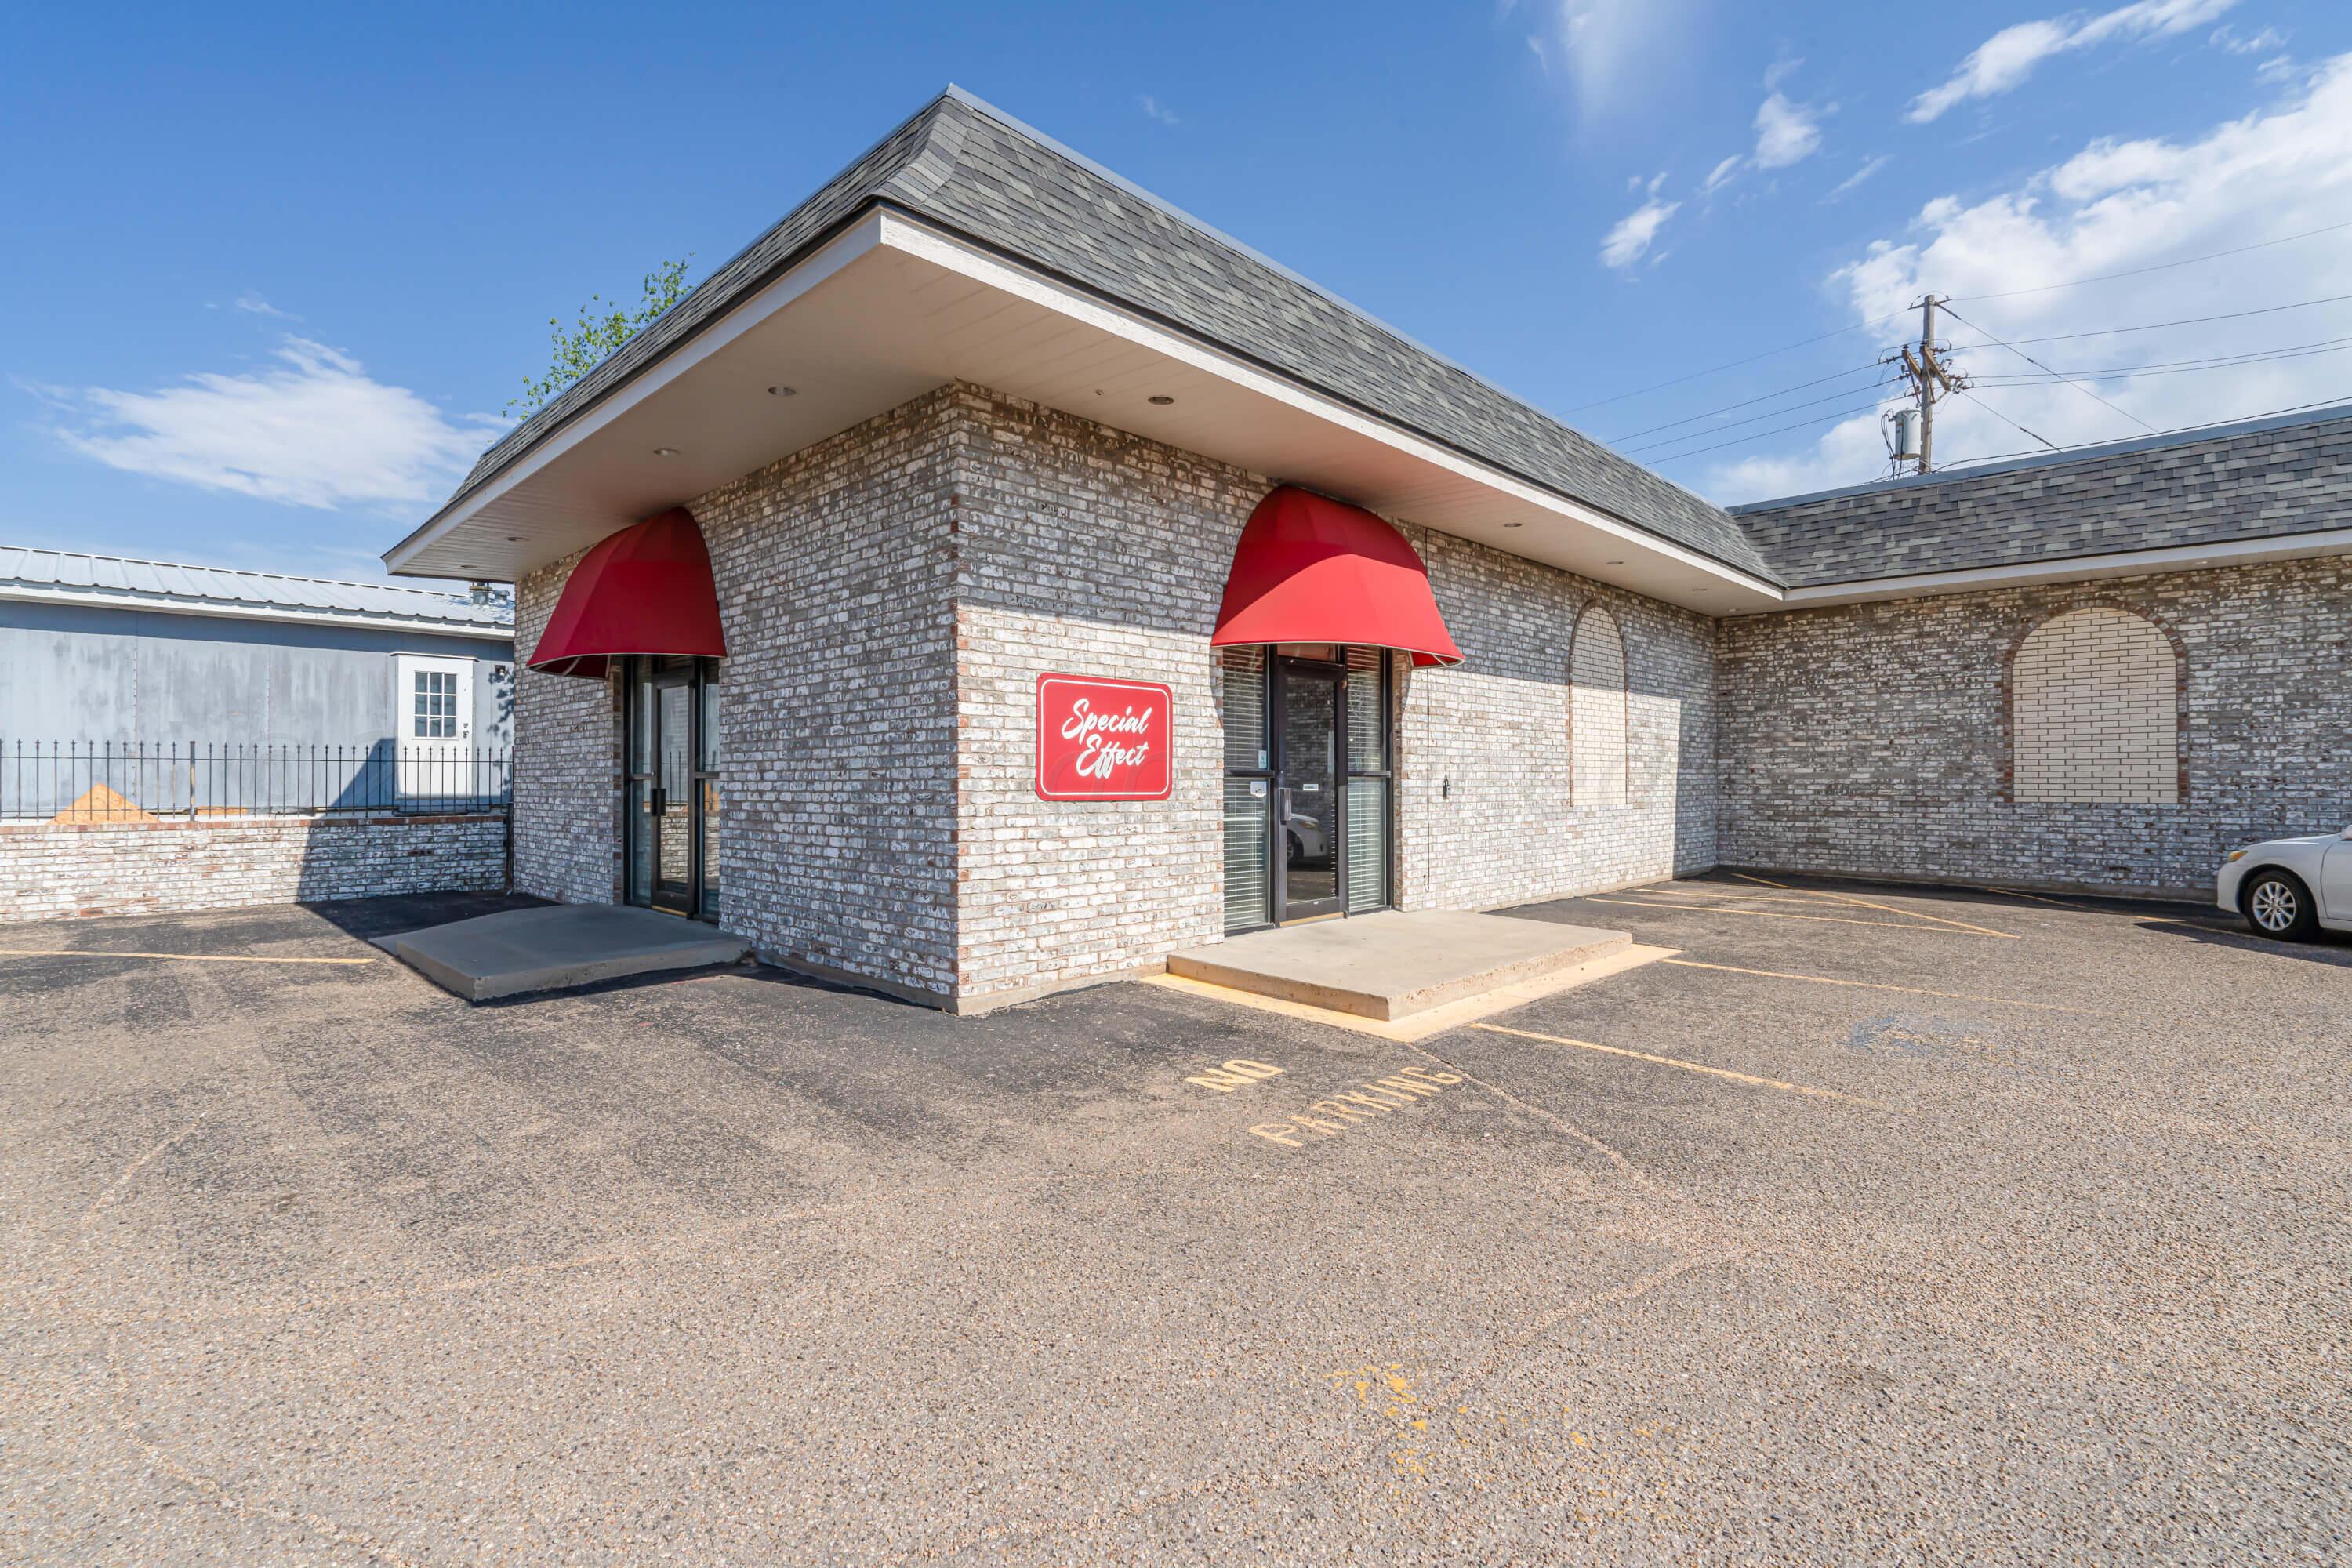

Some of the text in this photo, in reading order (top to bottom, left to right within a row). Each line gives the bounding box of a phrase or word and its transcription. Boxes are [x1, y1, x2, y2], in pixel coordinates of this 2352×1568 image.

[1061, 698, 1152, 745] Special
[1076, 733, 1149, 779] Effect
[1185, 1058, 1285, 1092] NO
[1248, 1066, 1463, 1148] PARKING
